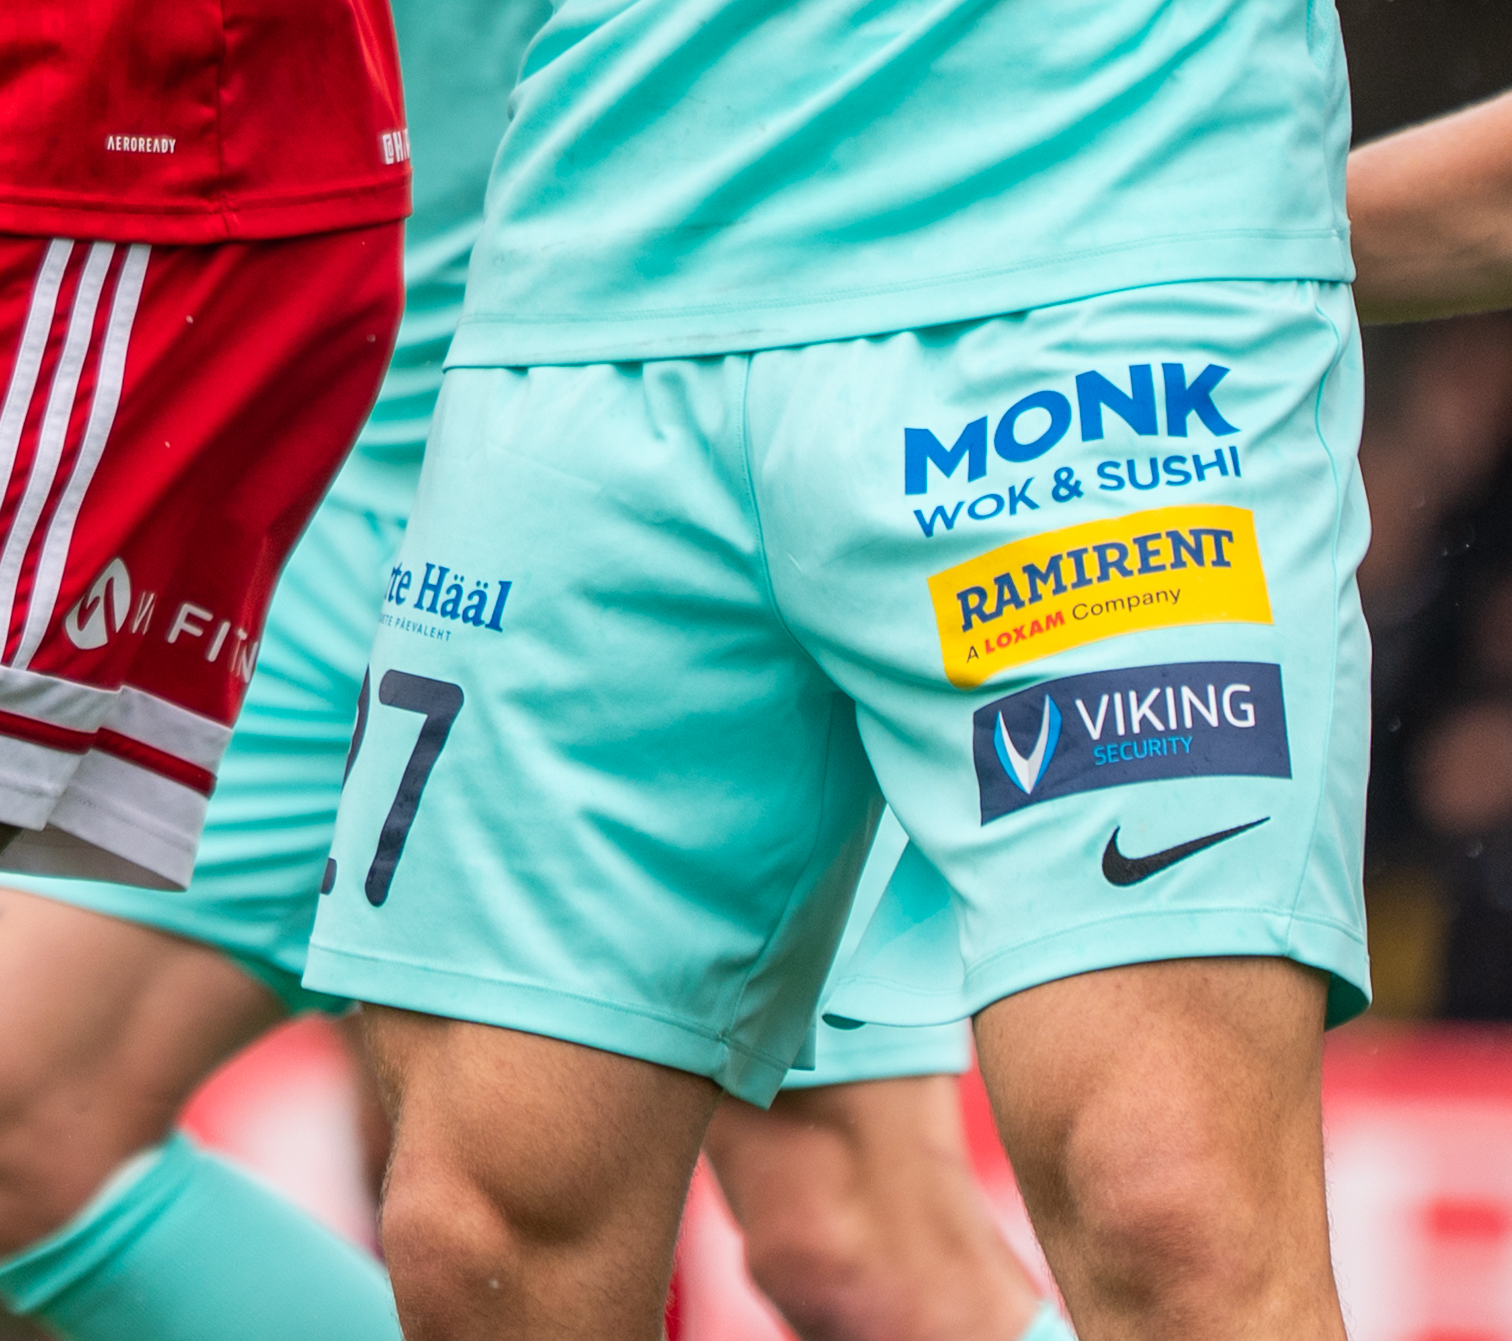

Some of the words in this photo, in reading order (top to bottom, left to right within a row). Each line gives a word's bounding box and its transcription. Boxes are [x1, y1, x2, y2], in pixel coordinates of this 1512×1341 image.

[106, 135, 176, 154] AEROREADY
[904, 362, 1241, 496] MONK
[913, 476, 1040, 539] WOK
[1051, 466, 1084, 503] &
[1096, 445, 1242, 492] SUSHI
[384, 561, 412, 606] te
[413, 561, 513, 634] Hääl
[956, 528, 1234, 633] RAMIRENT
[966, 645, 980, 664] A
[984, 610, 1067, 655] LOXAM
[1072, 587, 1182, 621] Company
[1075, 684, 1257, 741] VIKING
[320, 662, 465, 908] 7
[1093, 736, 1193, 767] SECURITY
